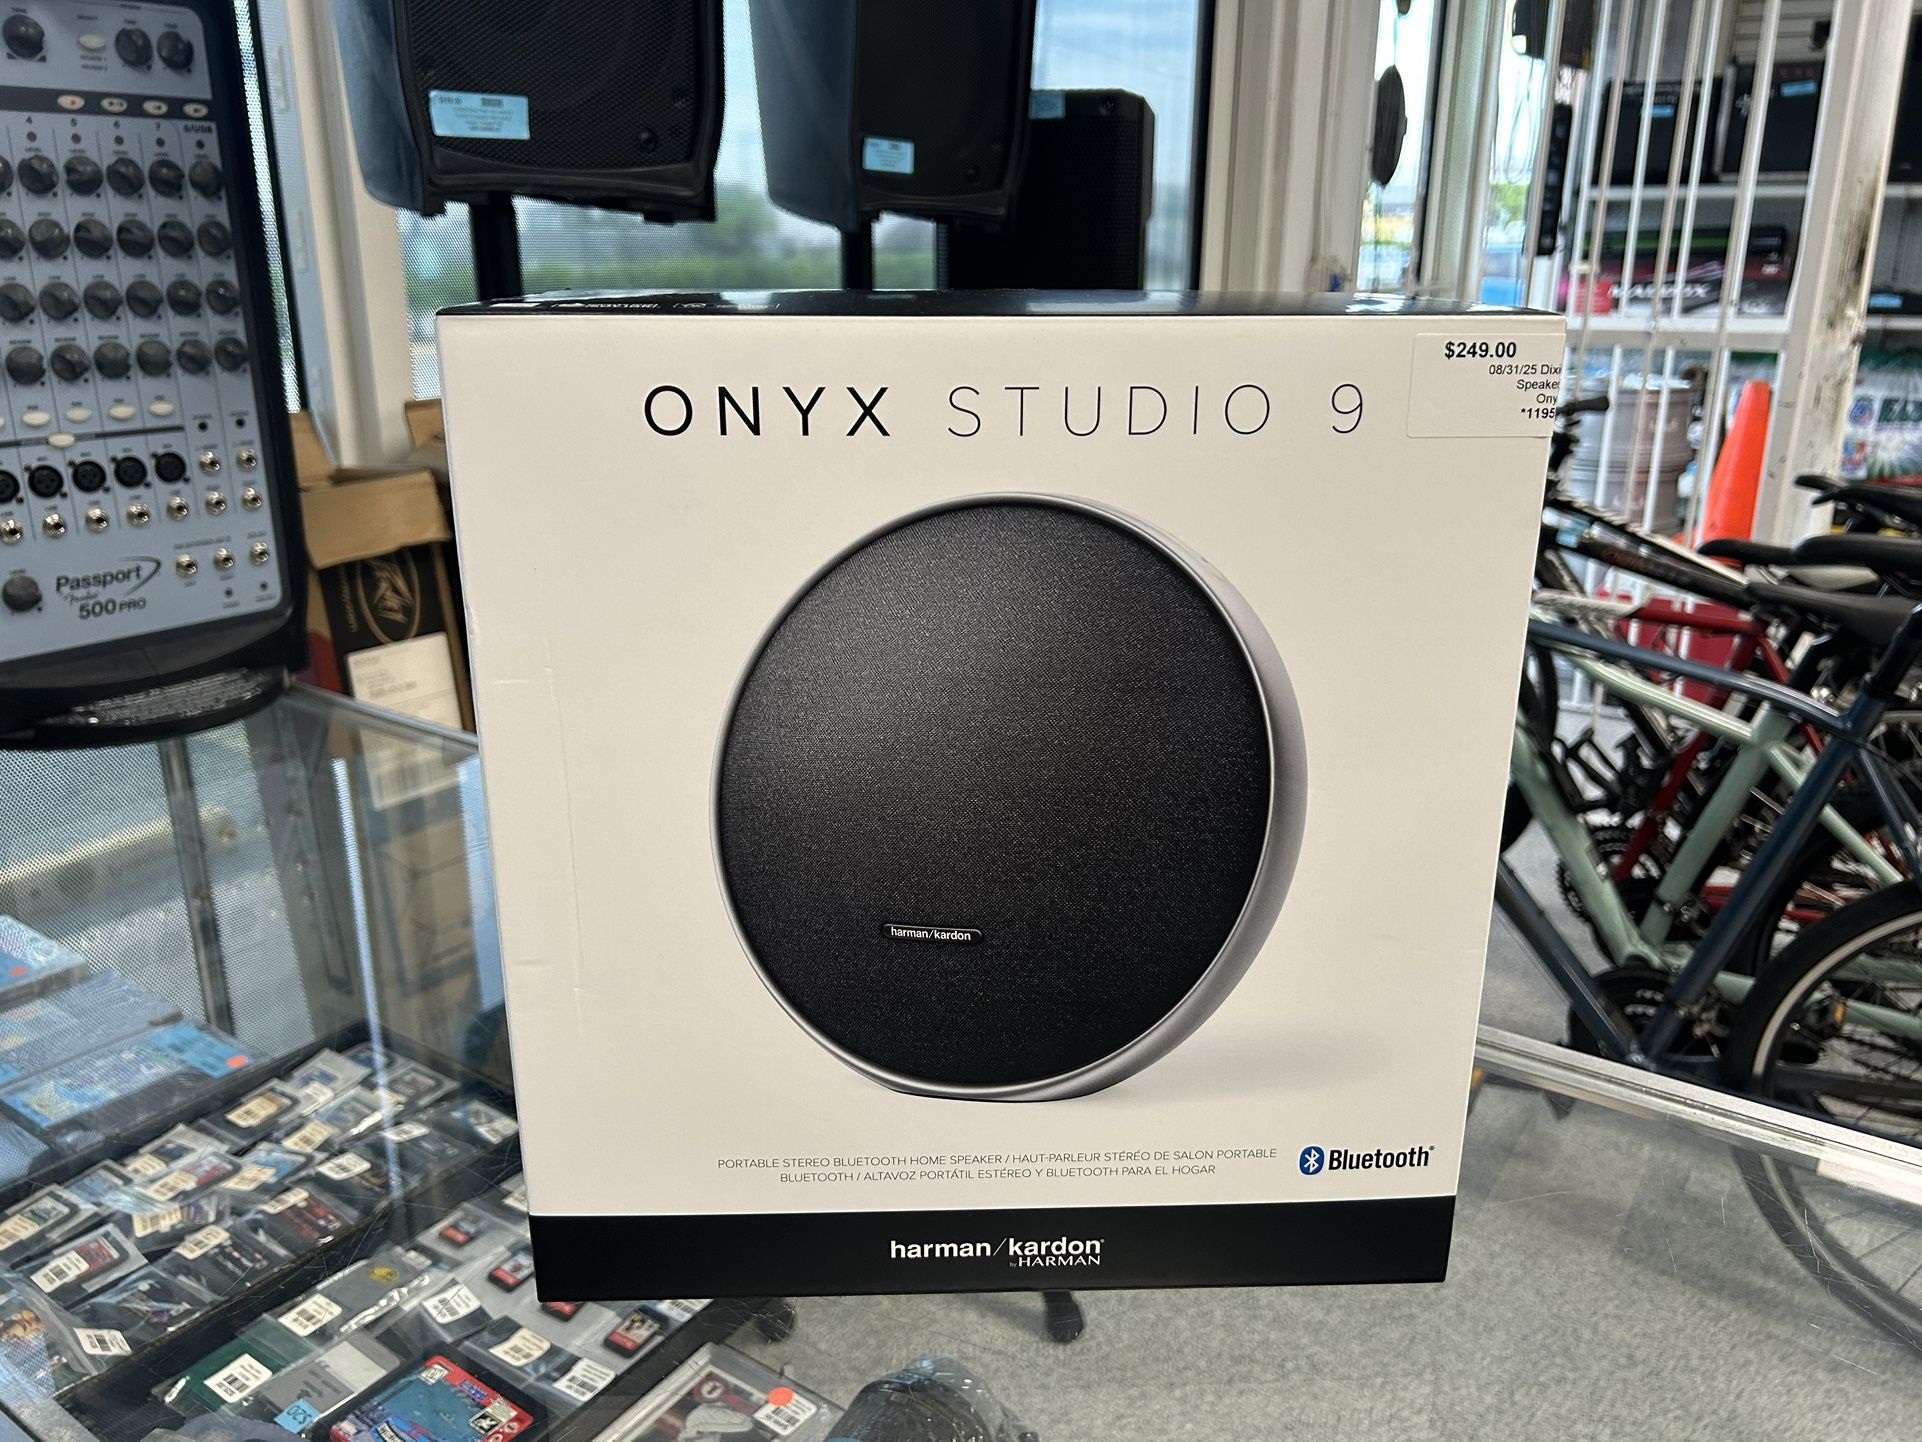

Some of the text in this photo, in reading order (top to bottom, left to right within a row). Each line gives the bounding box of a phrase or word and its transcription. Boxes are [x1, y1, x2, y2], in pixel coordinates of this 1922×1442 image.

[1444, 341, 1517, 360] $249.00
[1488, 364, 1538, 375] 08/31/25
[643, 383, 1364, 438] ONYX STUDIO 9
[56, 563, 142, 593] Passport
[79, 597, 146, 620] 500 PRO
[890, 926, 971, 940] harman/kardon
[718, 1158, 780, 1169] PORTABLE
[782, 1157, 830, 1168] STEREO
[833, 1156, 907, 1167] BLUETOOTH
[910, 1155, 946, 1165] HOME
[950, 1154, 1002, 1165] SPEAKER
[1012, 1152, 1101, 1163] HAUT-PARLEUR
[1104, 1149, 1151, 1162] STÉRÉO
[1154, 1151, 1170, 1161] DE
[1173, 1150, 1213, 1160] SALON
[1217, 1148, 1277, 1159] PORTABLE
[780, 1172, 854, 1183] BLUETOOTH
[863, 1170, 916, 1181] ALTAVOZ
[920, 1168, 974, 1179] PORTÁTIL
[978, 1167, 1032, 1179] ESTÉREO
[1035, 1168, 1043, 1178] Y
[1046, 1166, 1118, 1178] BLUETOOTH
[1121, 1166, 1152, 1176] PARA
[1155, 1165, 1168, 1175] EL
[1172, 1164, 1216, 1175] HOGAR
[1018, 1254, 1101, 1267] HARMAN
